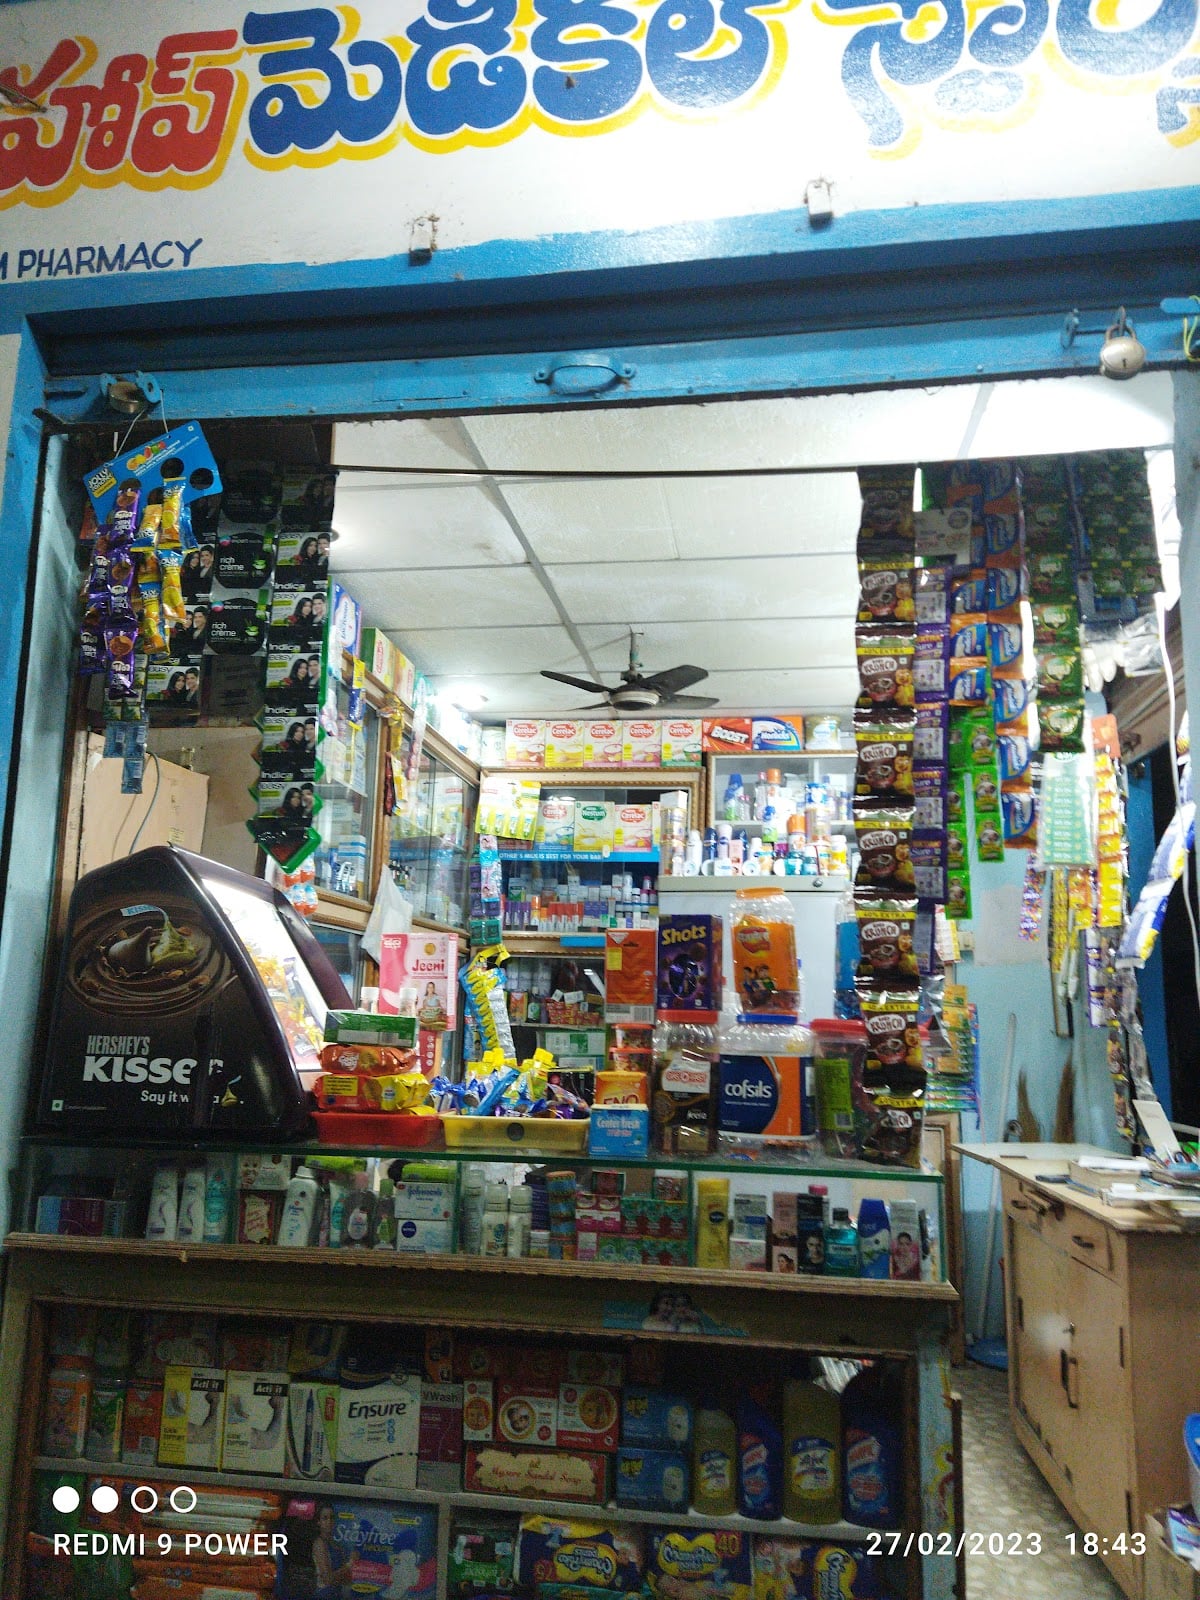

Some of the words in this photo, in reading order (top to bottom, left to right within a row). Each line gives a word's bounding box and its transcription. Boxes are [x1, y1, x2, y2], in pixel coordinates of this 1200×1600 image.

[17, 239, 202, 278] PHARMACY
[220, 556, 235, 565] rich
[212, 622, 227, 631] rich
[552, 727, 577, 735] Cerelac
[660, 925, 707, 946] Shots
[864, 925, 897, 939] KRUNCH
[870, 1018, 903, 1033] KRUNCH
[86, 1034, 151, 1055] HERSHEY'S
[140, 1089, 167, 1105] Say
[168, 1090, 178, 1103] it
[724, 1079, 774, 1099] cofsils
[597, 1116, 619, 1129] Center
[621, 1115, 640, 1129] fresh
[347, 1401, 407, 1420] Ensure
[333, 1522, 397, 1548] Stayfree
